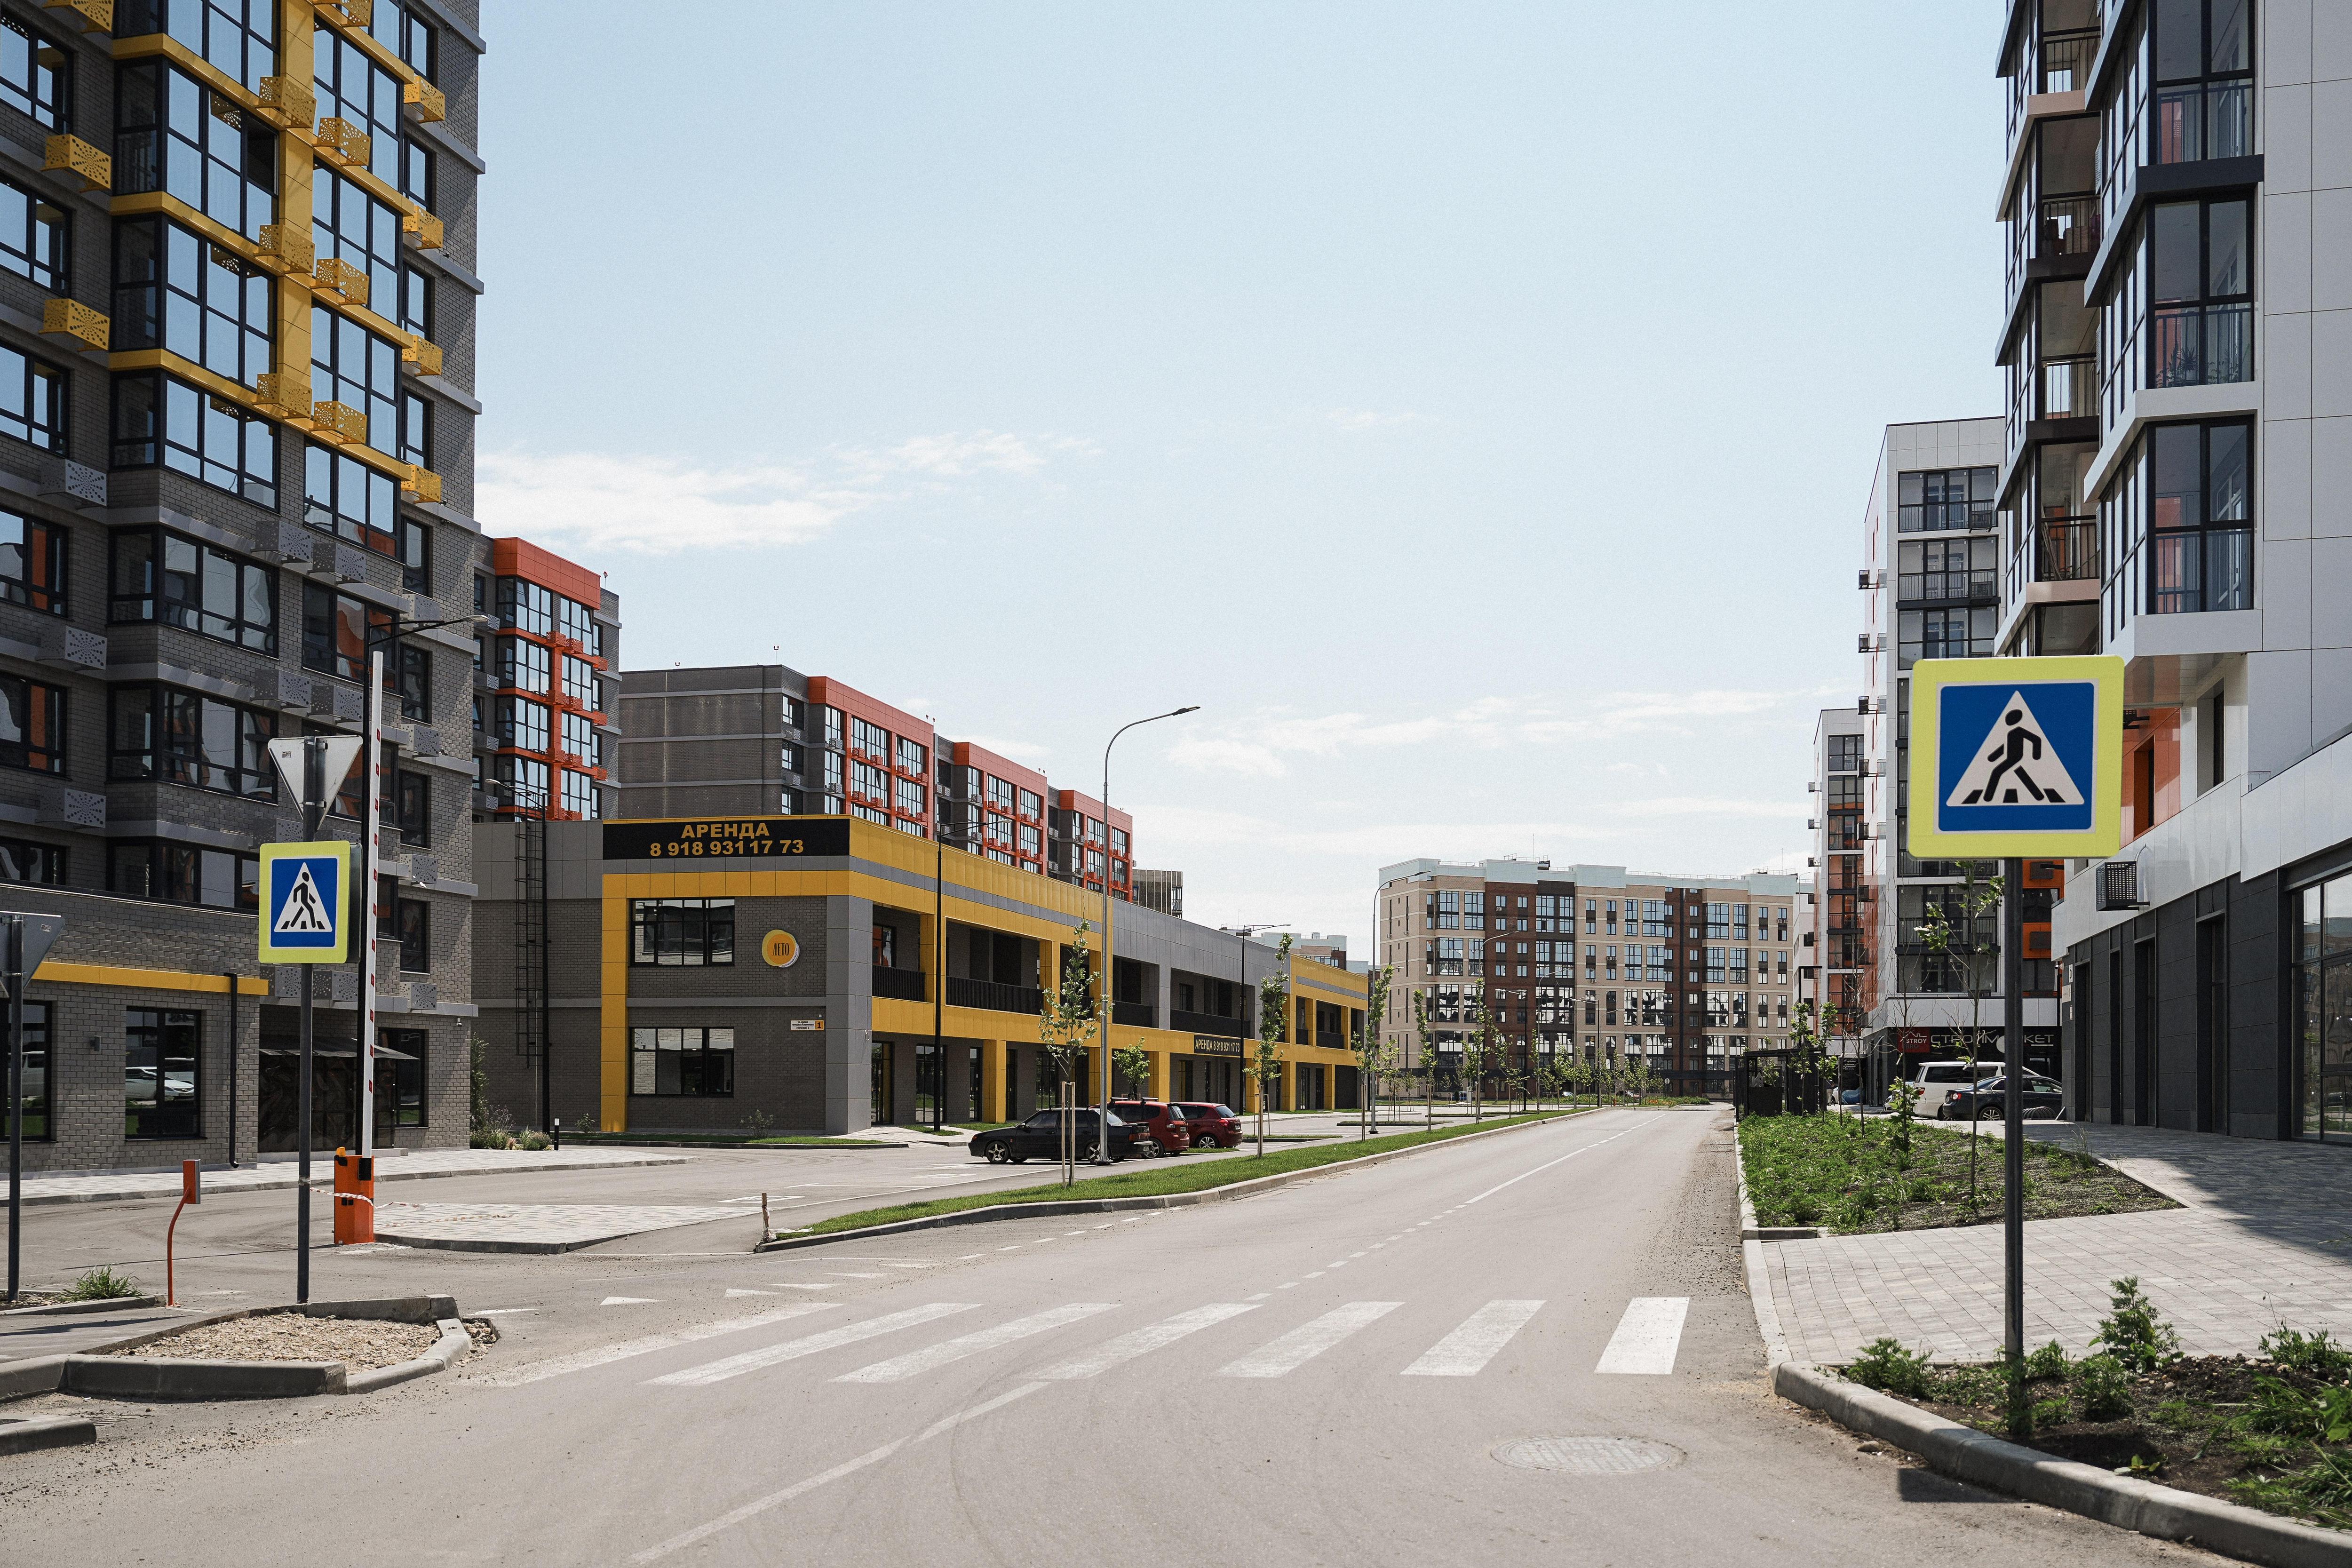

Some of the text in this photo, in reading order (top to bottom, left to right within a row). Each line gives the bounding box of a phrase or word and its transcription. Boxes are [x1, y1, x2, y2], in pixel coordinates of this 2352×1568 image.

[681, 822, 770, 839] АРЕНДА
[650, 839, 803, 856] 8 918 931 17 73
[772, 943, 789, 955] ЛЕТО
[1195, 1039, 1212, 1051] АРЕНДА
[1214, 1041, 1216, 1051] 8
[1231, 1043, 1235, 1052] 17
[1236, 1043, 1240, 1052] 73
